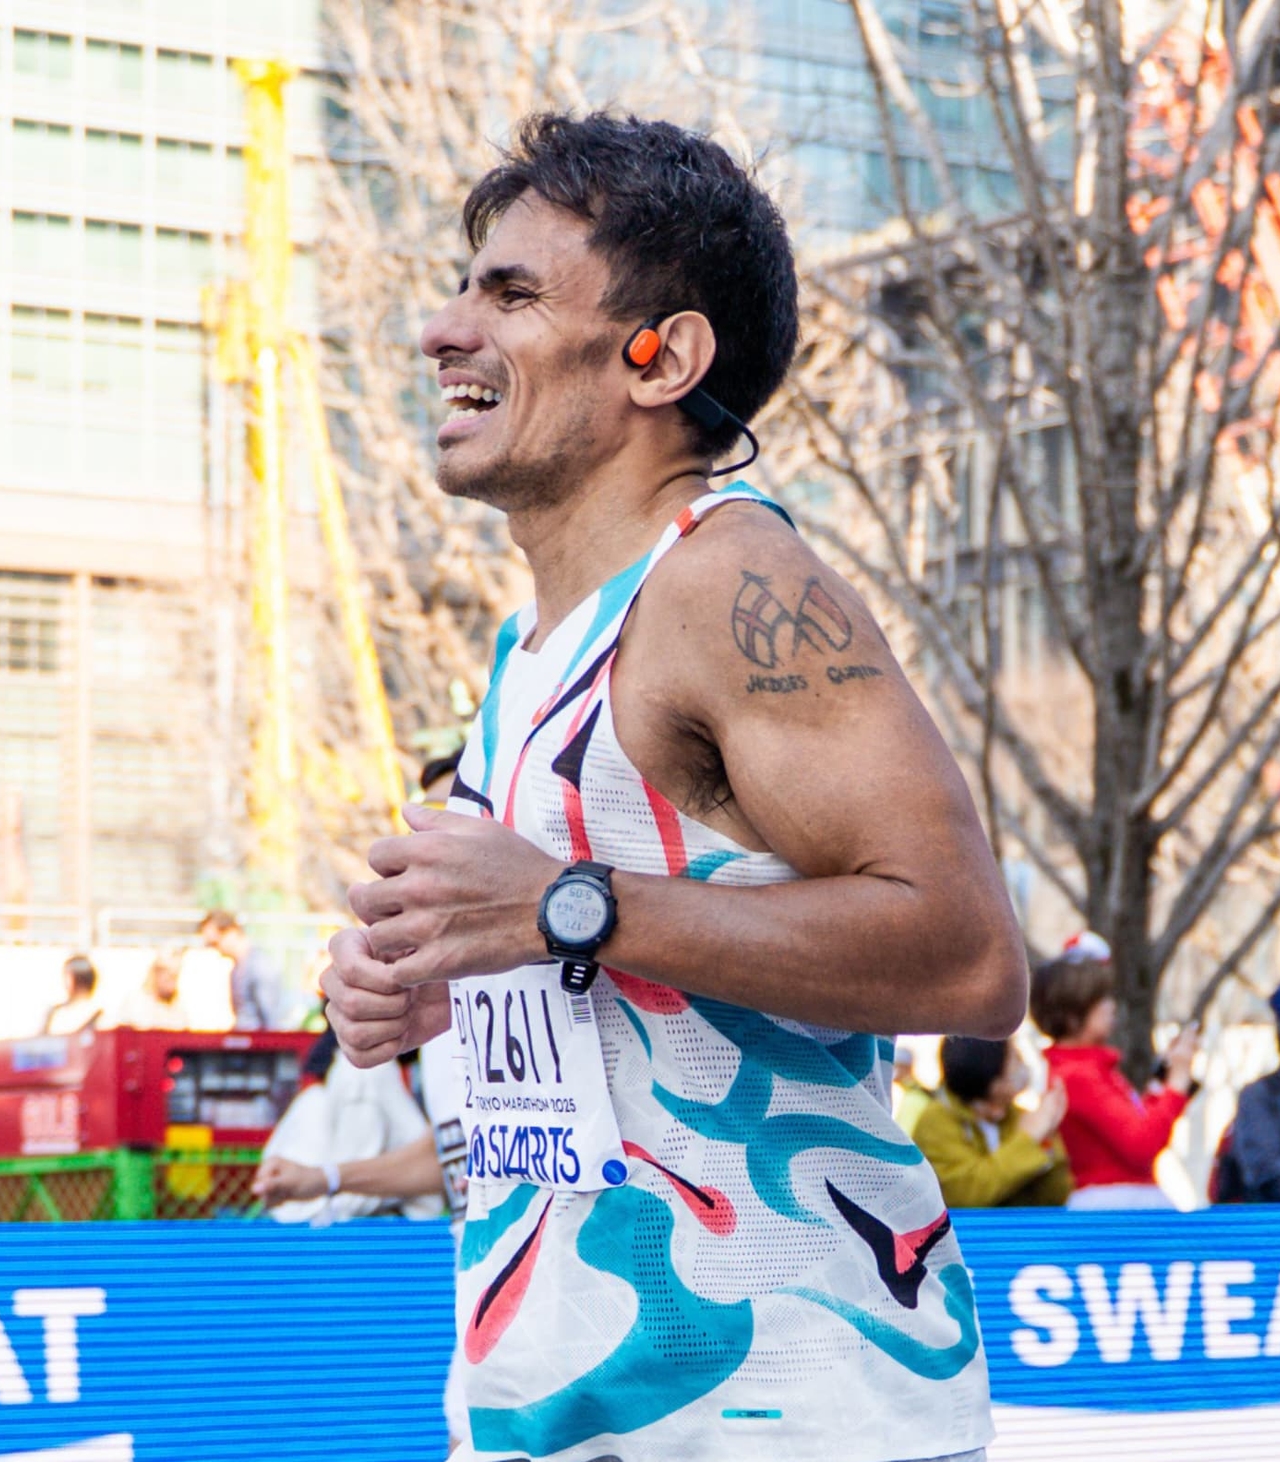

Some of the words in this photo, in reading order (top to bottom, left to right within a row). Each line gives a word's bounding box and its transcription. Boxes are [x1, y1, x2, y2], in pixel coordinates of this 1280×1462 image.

[475, 1095, 501, 1111] TOKYO
[502, 1097, 549, 1112] MARATHON
[550, 1098, 576, 1113] 2025
